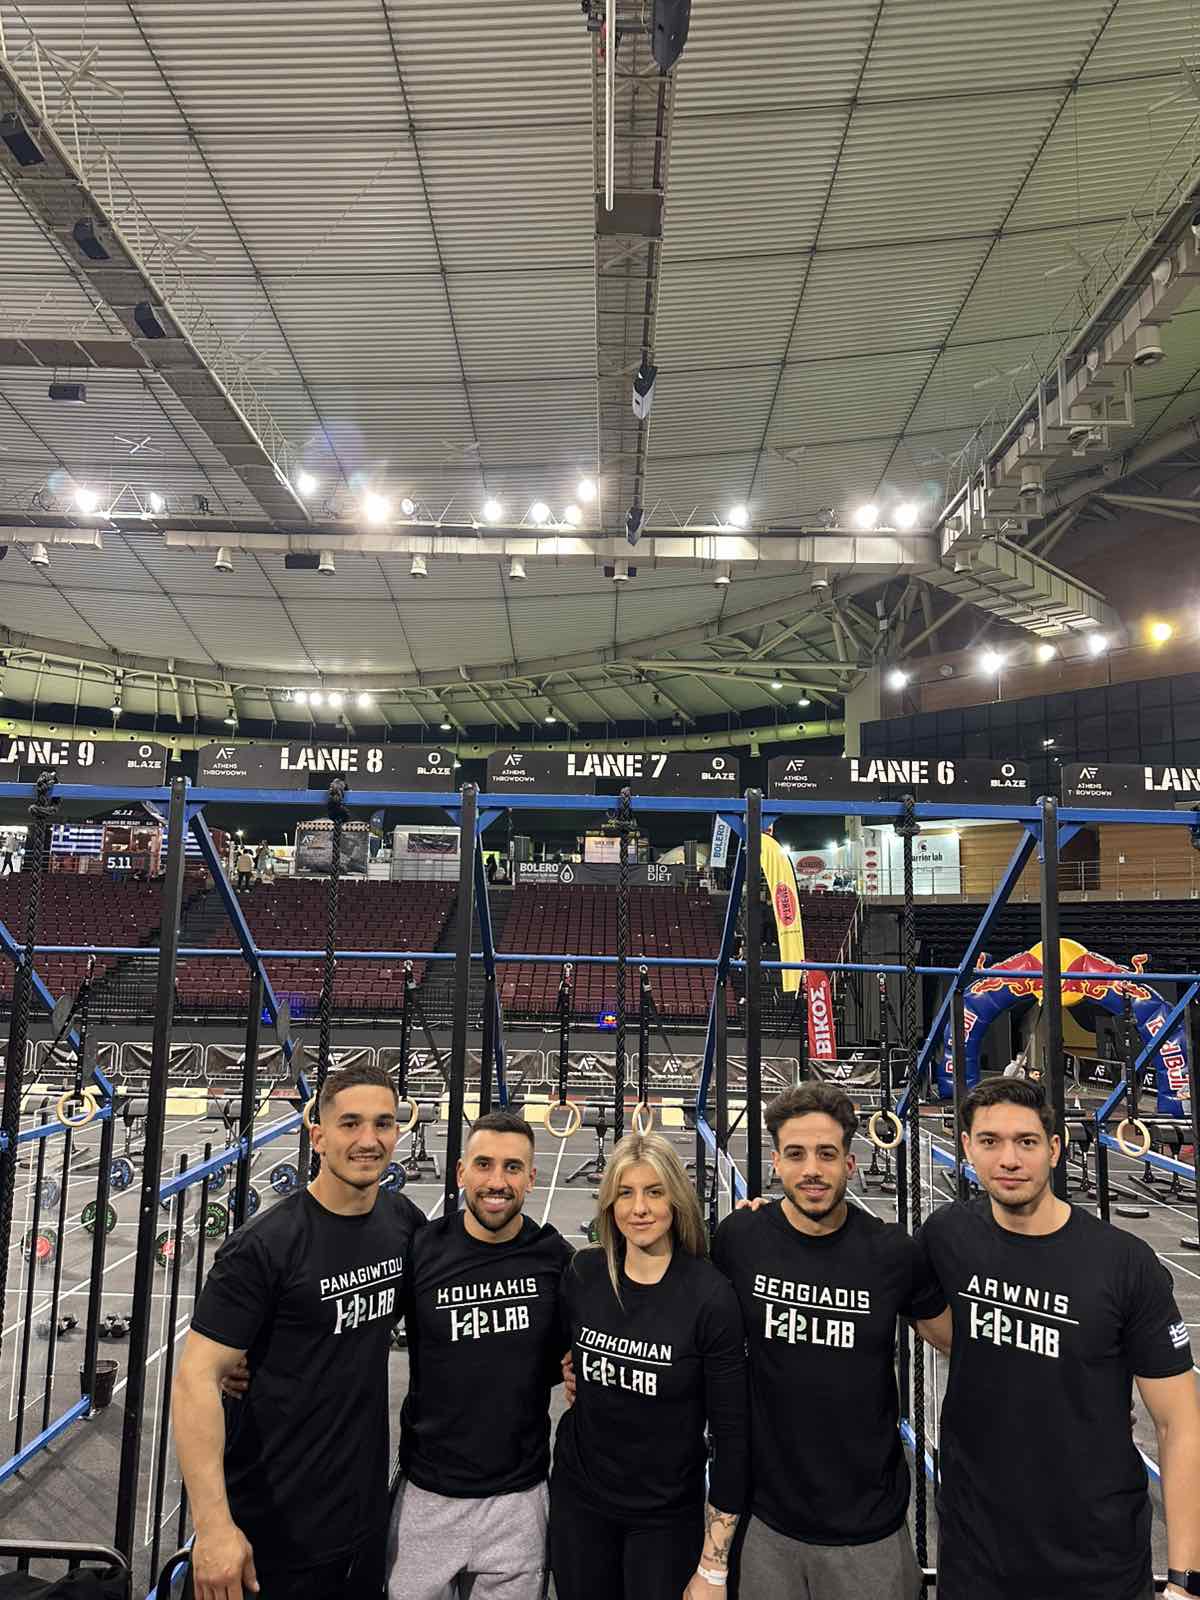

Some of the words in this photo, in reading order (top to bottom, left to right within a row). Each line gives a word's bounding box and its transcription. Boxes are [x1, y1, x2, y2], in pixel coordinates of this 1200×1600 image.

[78, 741, 95, 767] 9
[127, 760, 162, 769] BLAZE
[280, 747, 359, 772] LANE
[366, 748, 383, 773] 8
[567, 753, 643, 777] LANE
[651, 754, 668, 778] 7
[417, 767, 451, 775] BLAZE
[701, 772, 736, 781] BLAZE
[850, 759, 929, 783] LANE
[937, 760, 955, 785] 6
[990, 779, 1027, 788] BLAZE
[713, 824, 726, 858] BOLERO
[107, 856, 132, 869] 5.11
[519, 863, 559, 873] BOLERO
[1164, 1053, 1191, 1091] Bull
[320, 1256, 403, 1295] PANAGIWTOU
[437, 1277, 537, 1304] KOUKAKIS
[753, 1274, 871, 1309] SERGIADIS
[967, 1274, 1070, 1315] ARWNIS
[580, 1326, 672, 1361] TORKOMIAN
